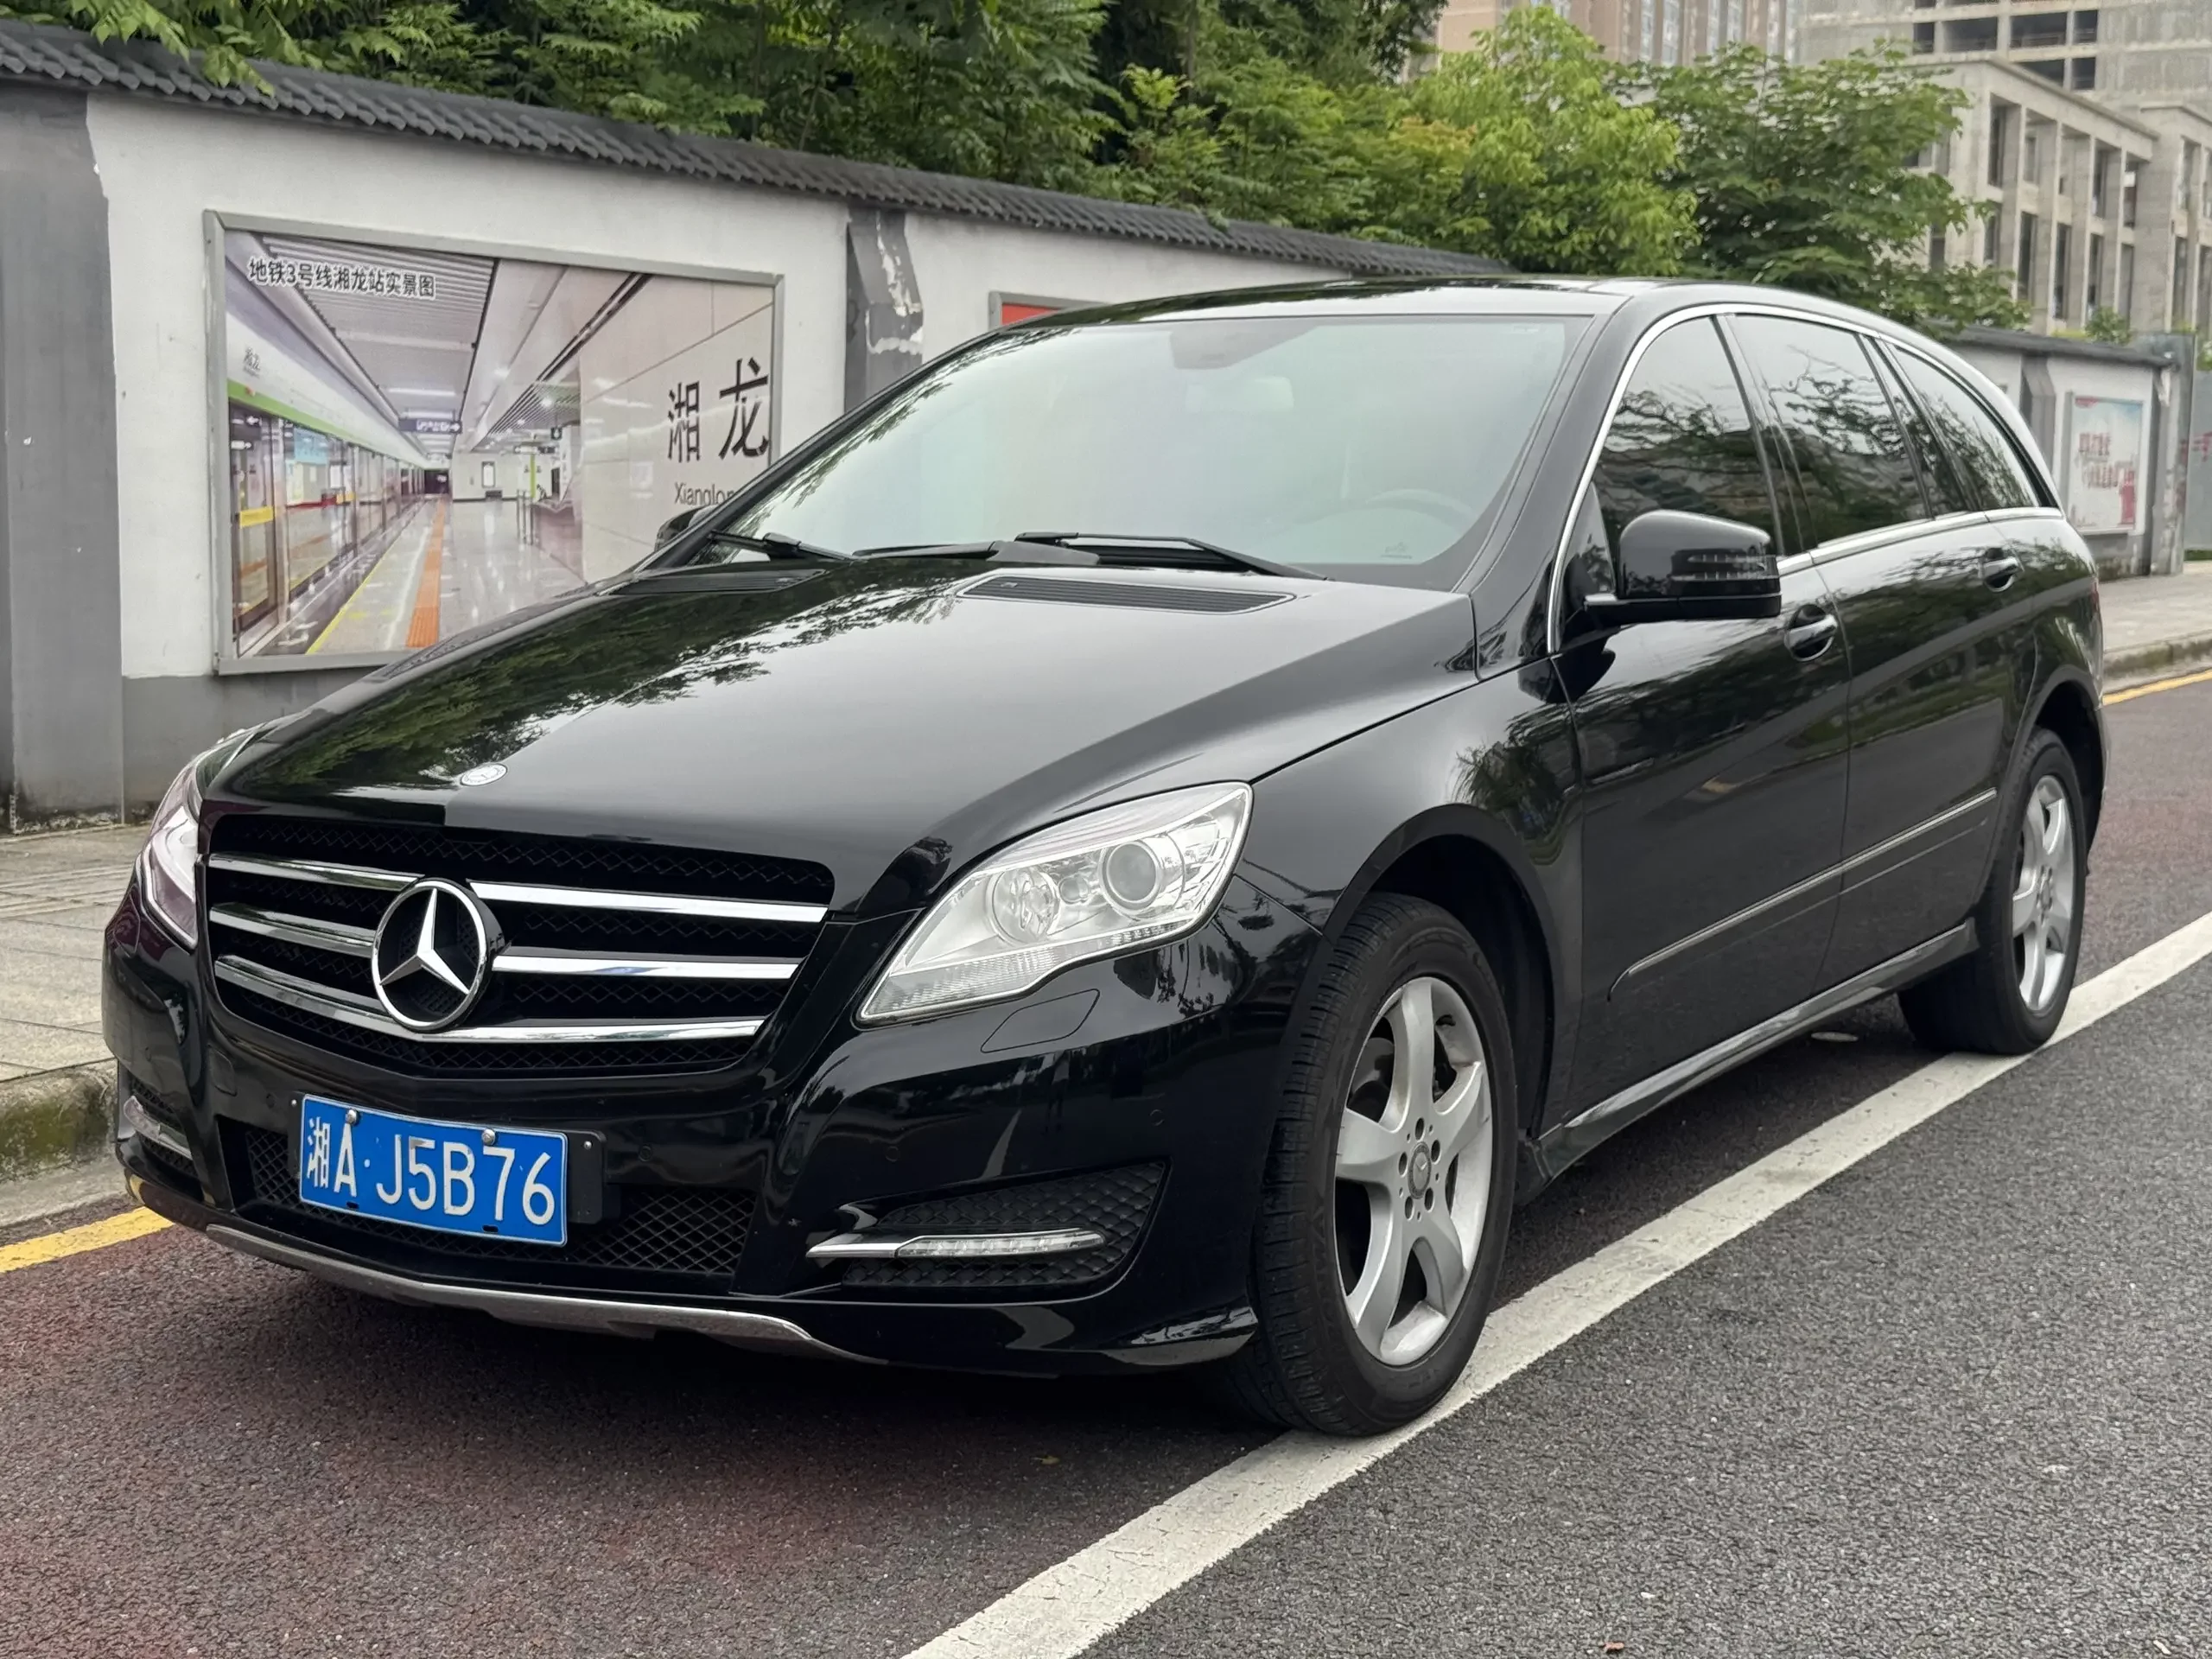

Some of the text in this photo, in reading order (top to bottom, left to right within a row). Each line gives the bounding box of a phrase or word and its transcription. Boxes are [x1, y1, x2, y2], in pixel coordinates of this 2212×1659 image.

[249, 258, 435, 297] 地铁3号线湘龙站实景图
[668, 357, 769, 462] 湘龙
